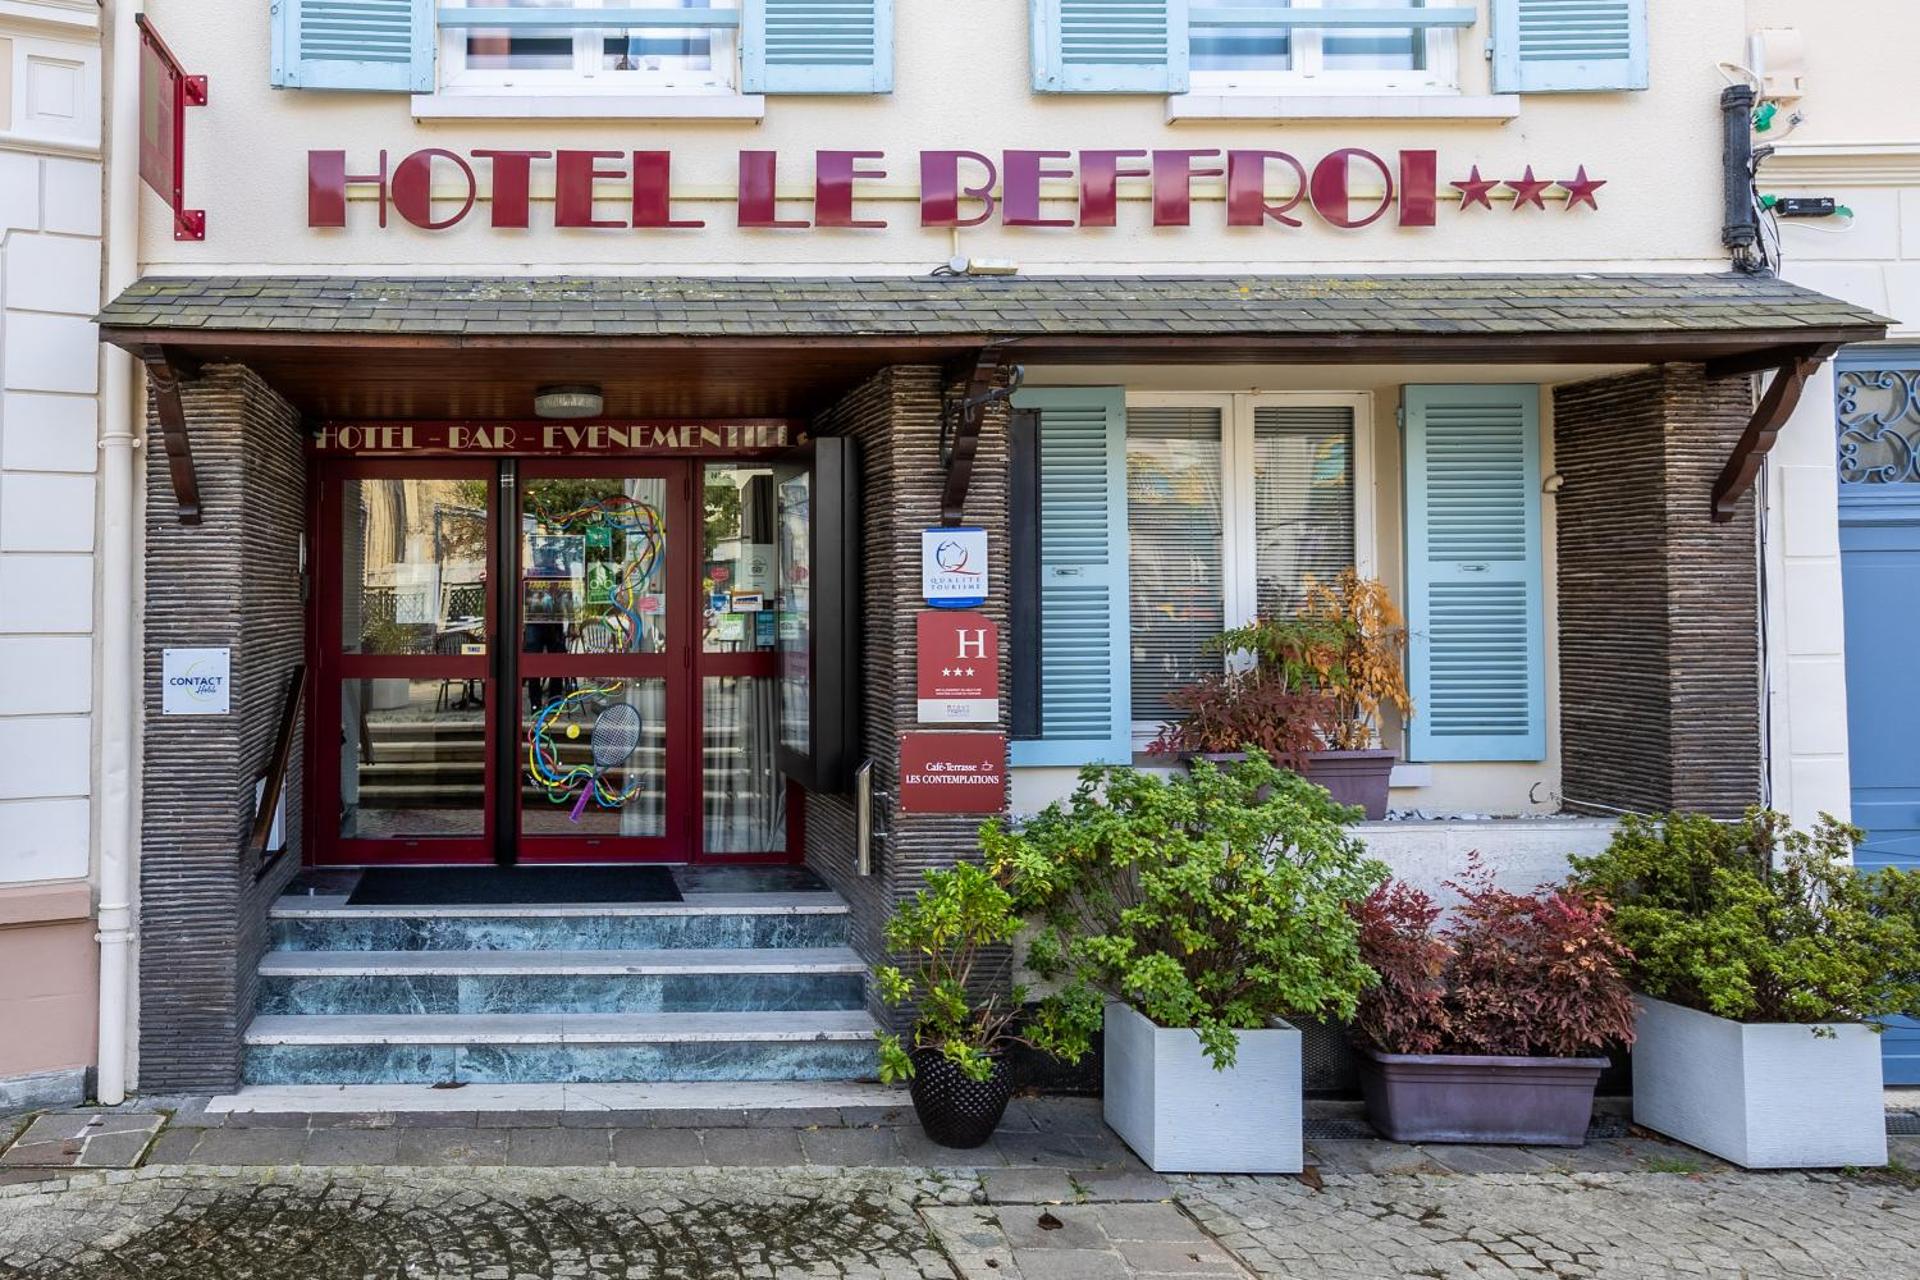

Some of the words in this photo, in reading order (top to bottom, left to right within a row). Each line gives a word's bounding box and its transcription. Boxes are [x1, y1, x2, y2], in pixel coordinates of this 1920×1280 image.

[308, 148, 705, 229] HOTEL
[737, 150, 887, 228] LE
[920, 147, 1437, 229] BEFFROI
[315, 426, 422, 449] HOTEL
[449, 426, 515, 449] BAR
[543, 425, 796, 448] EVENEMENTIEL
[955, 629, 988, 658] H
[170, 677, 223, 685] CONTACT
[925, 761, 978, 772] Café-Terrasse
[905, 774, 921, 784] LES
[922, 774, 999, 784] CONTEMPLATIONS
